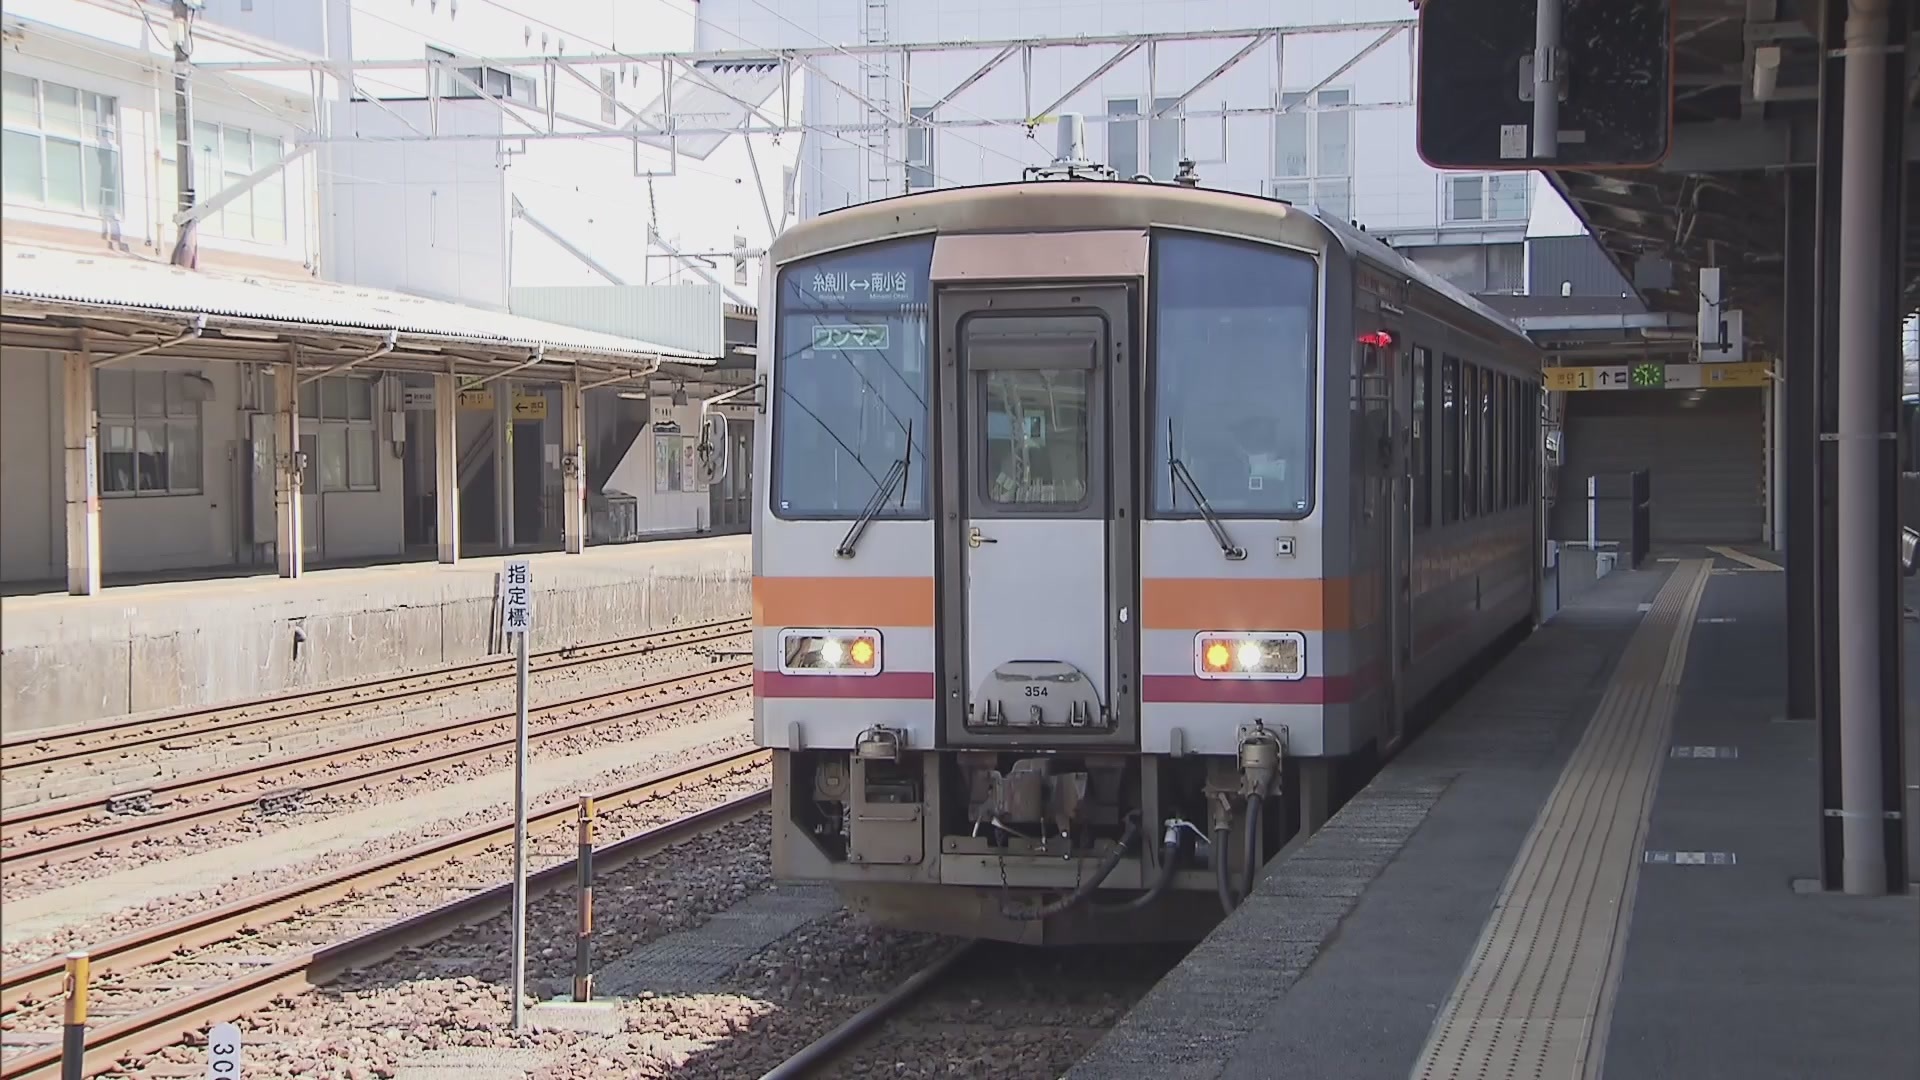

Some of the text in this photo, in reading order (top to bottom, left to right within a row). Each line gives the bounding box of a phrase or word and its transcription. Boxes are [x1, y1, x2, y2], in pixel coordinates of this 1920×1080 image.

[813, 272, 848, 292] 糸魚川
[871, 272, 907, 292] 南小谷
[815, 328, 885, 347] ワンマン
[507, 564, 527, 627] 指定標
[1024, 686, 1048, 697] 354
